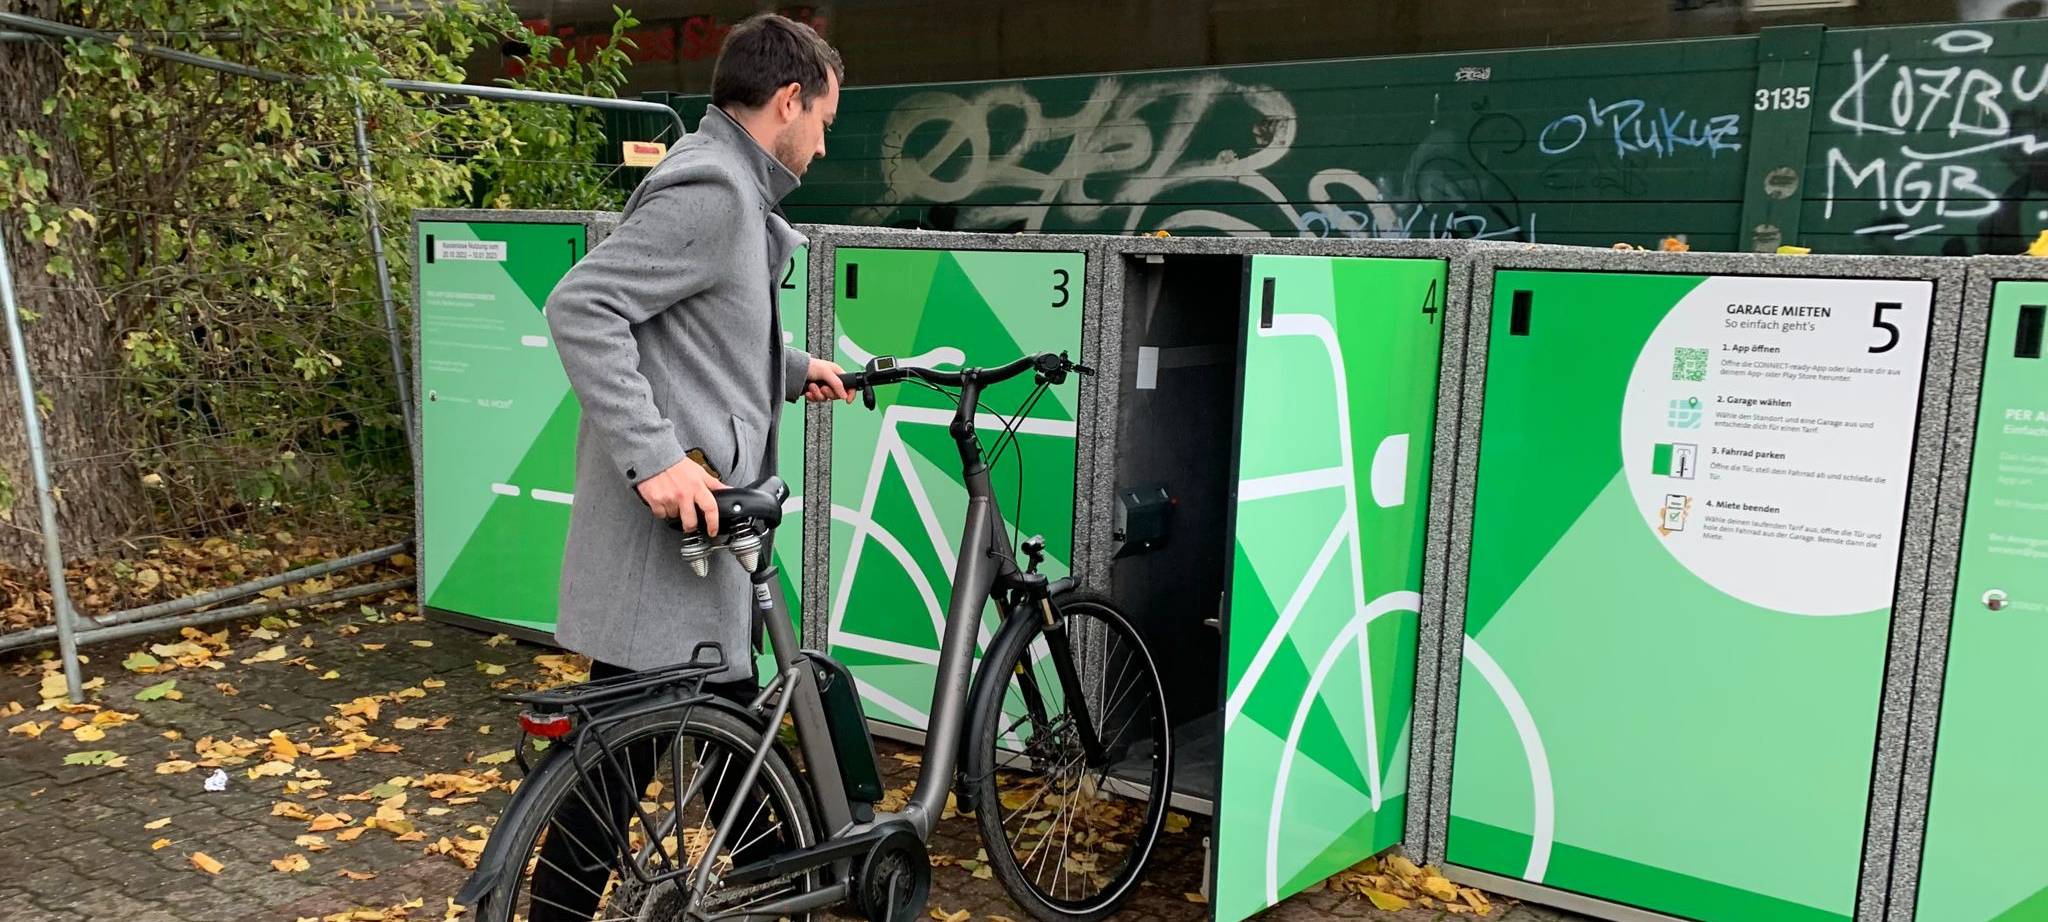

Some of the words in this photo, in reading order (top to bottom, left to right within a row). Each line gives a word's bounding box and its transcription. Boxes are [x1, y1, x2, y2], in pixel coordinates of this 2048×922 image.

[1754, 87, 1811, 111] 3135
[1825, 148, 2001, 219] MGB
[567, 238, 577, 265] 1
[781, 254, 796, 289] 2
[1051, 269, 1070, 308] 3
[1422, 278, 1438, 325] 4
[1726, 304, 1779, 316] GARAGE
[1781, 306, 1832, 318] MIETEN
[1724, 319, 1738, 329] So
[1740, 319, 1780, 330] einfach
[1781, 321, 1816, 333] geht's
[1867, 302, 1903, 354] 5
[1722, 344, 1731, 352] 1.
[1732, 344, 1750, 354] App
[1751, 344, 1781, 353] öffnen
[1716, 395, 1725, 403] 2.
[1726, 396, 1758, 407] Garage
[1759, 398, 1792, 407] wählen
[2005, 408, 2033, 421] PER
[1711, 447, 1720, 455] 3.
[1721, 447, 1754, 457] Fahrrad
[1755, 451, 1786, 460] parken
[1716, 501, 1741, 510] Miete
[1743, 503, 1780, 514] beenden
